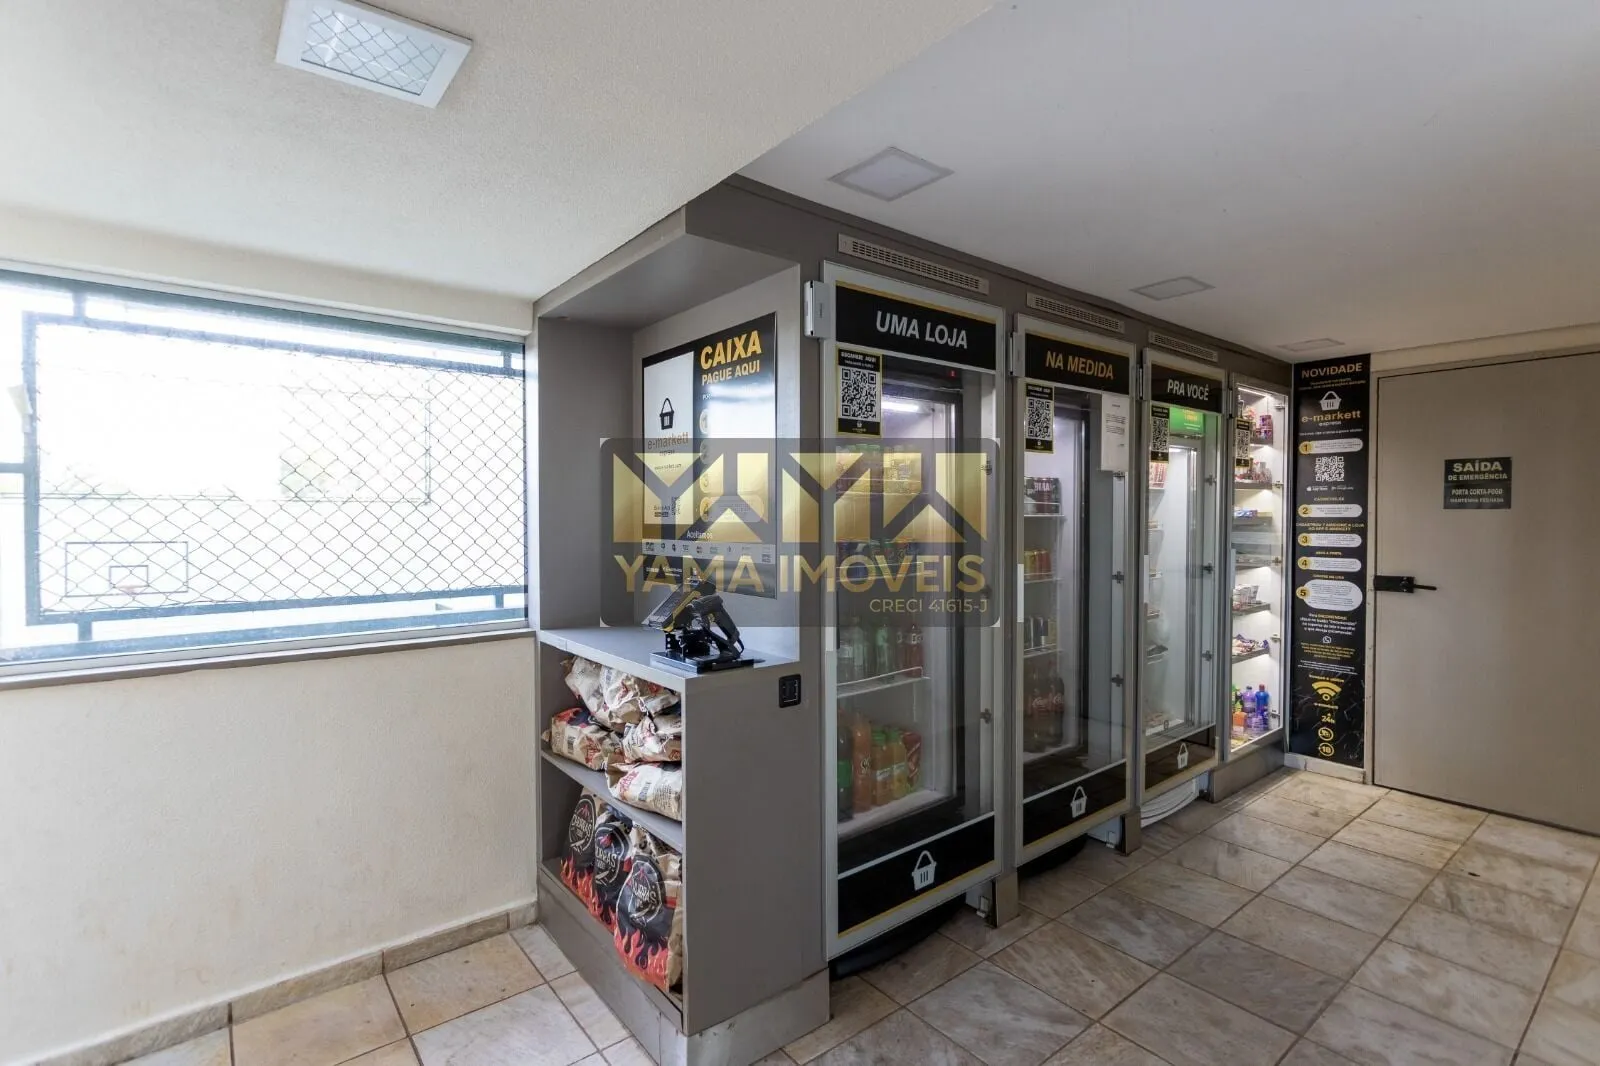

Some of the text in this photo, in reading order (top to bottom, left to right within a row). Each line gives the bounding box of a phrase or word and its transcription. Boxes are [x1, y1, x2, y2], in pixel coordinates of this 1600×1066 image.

[876, 311, 968, 349] UMA LOJA
[700, 330, 762, 370] CAIXA
[1045, 351, 1114, 380] NA MEDIDA
[1301, 363, 1363, 378] NOVIDADE
[702, 360, 760, 386] PAGUE AQUI
[1167, 379, 1185, 397] PRA
[1301, 410, 1361, 423] e-markett
[1453, 460, 1503, 472] SAÍDA
[1302, 535, 1308, 543] 3
[1302, 560, 1308, 568] 4
[1300, 589, 1307, 597] 5
[1321, 715, 1335, 724] 24h
